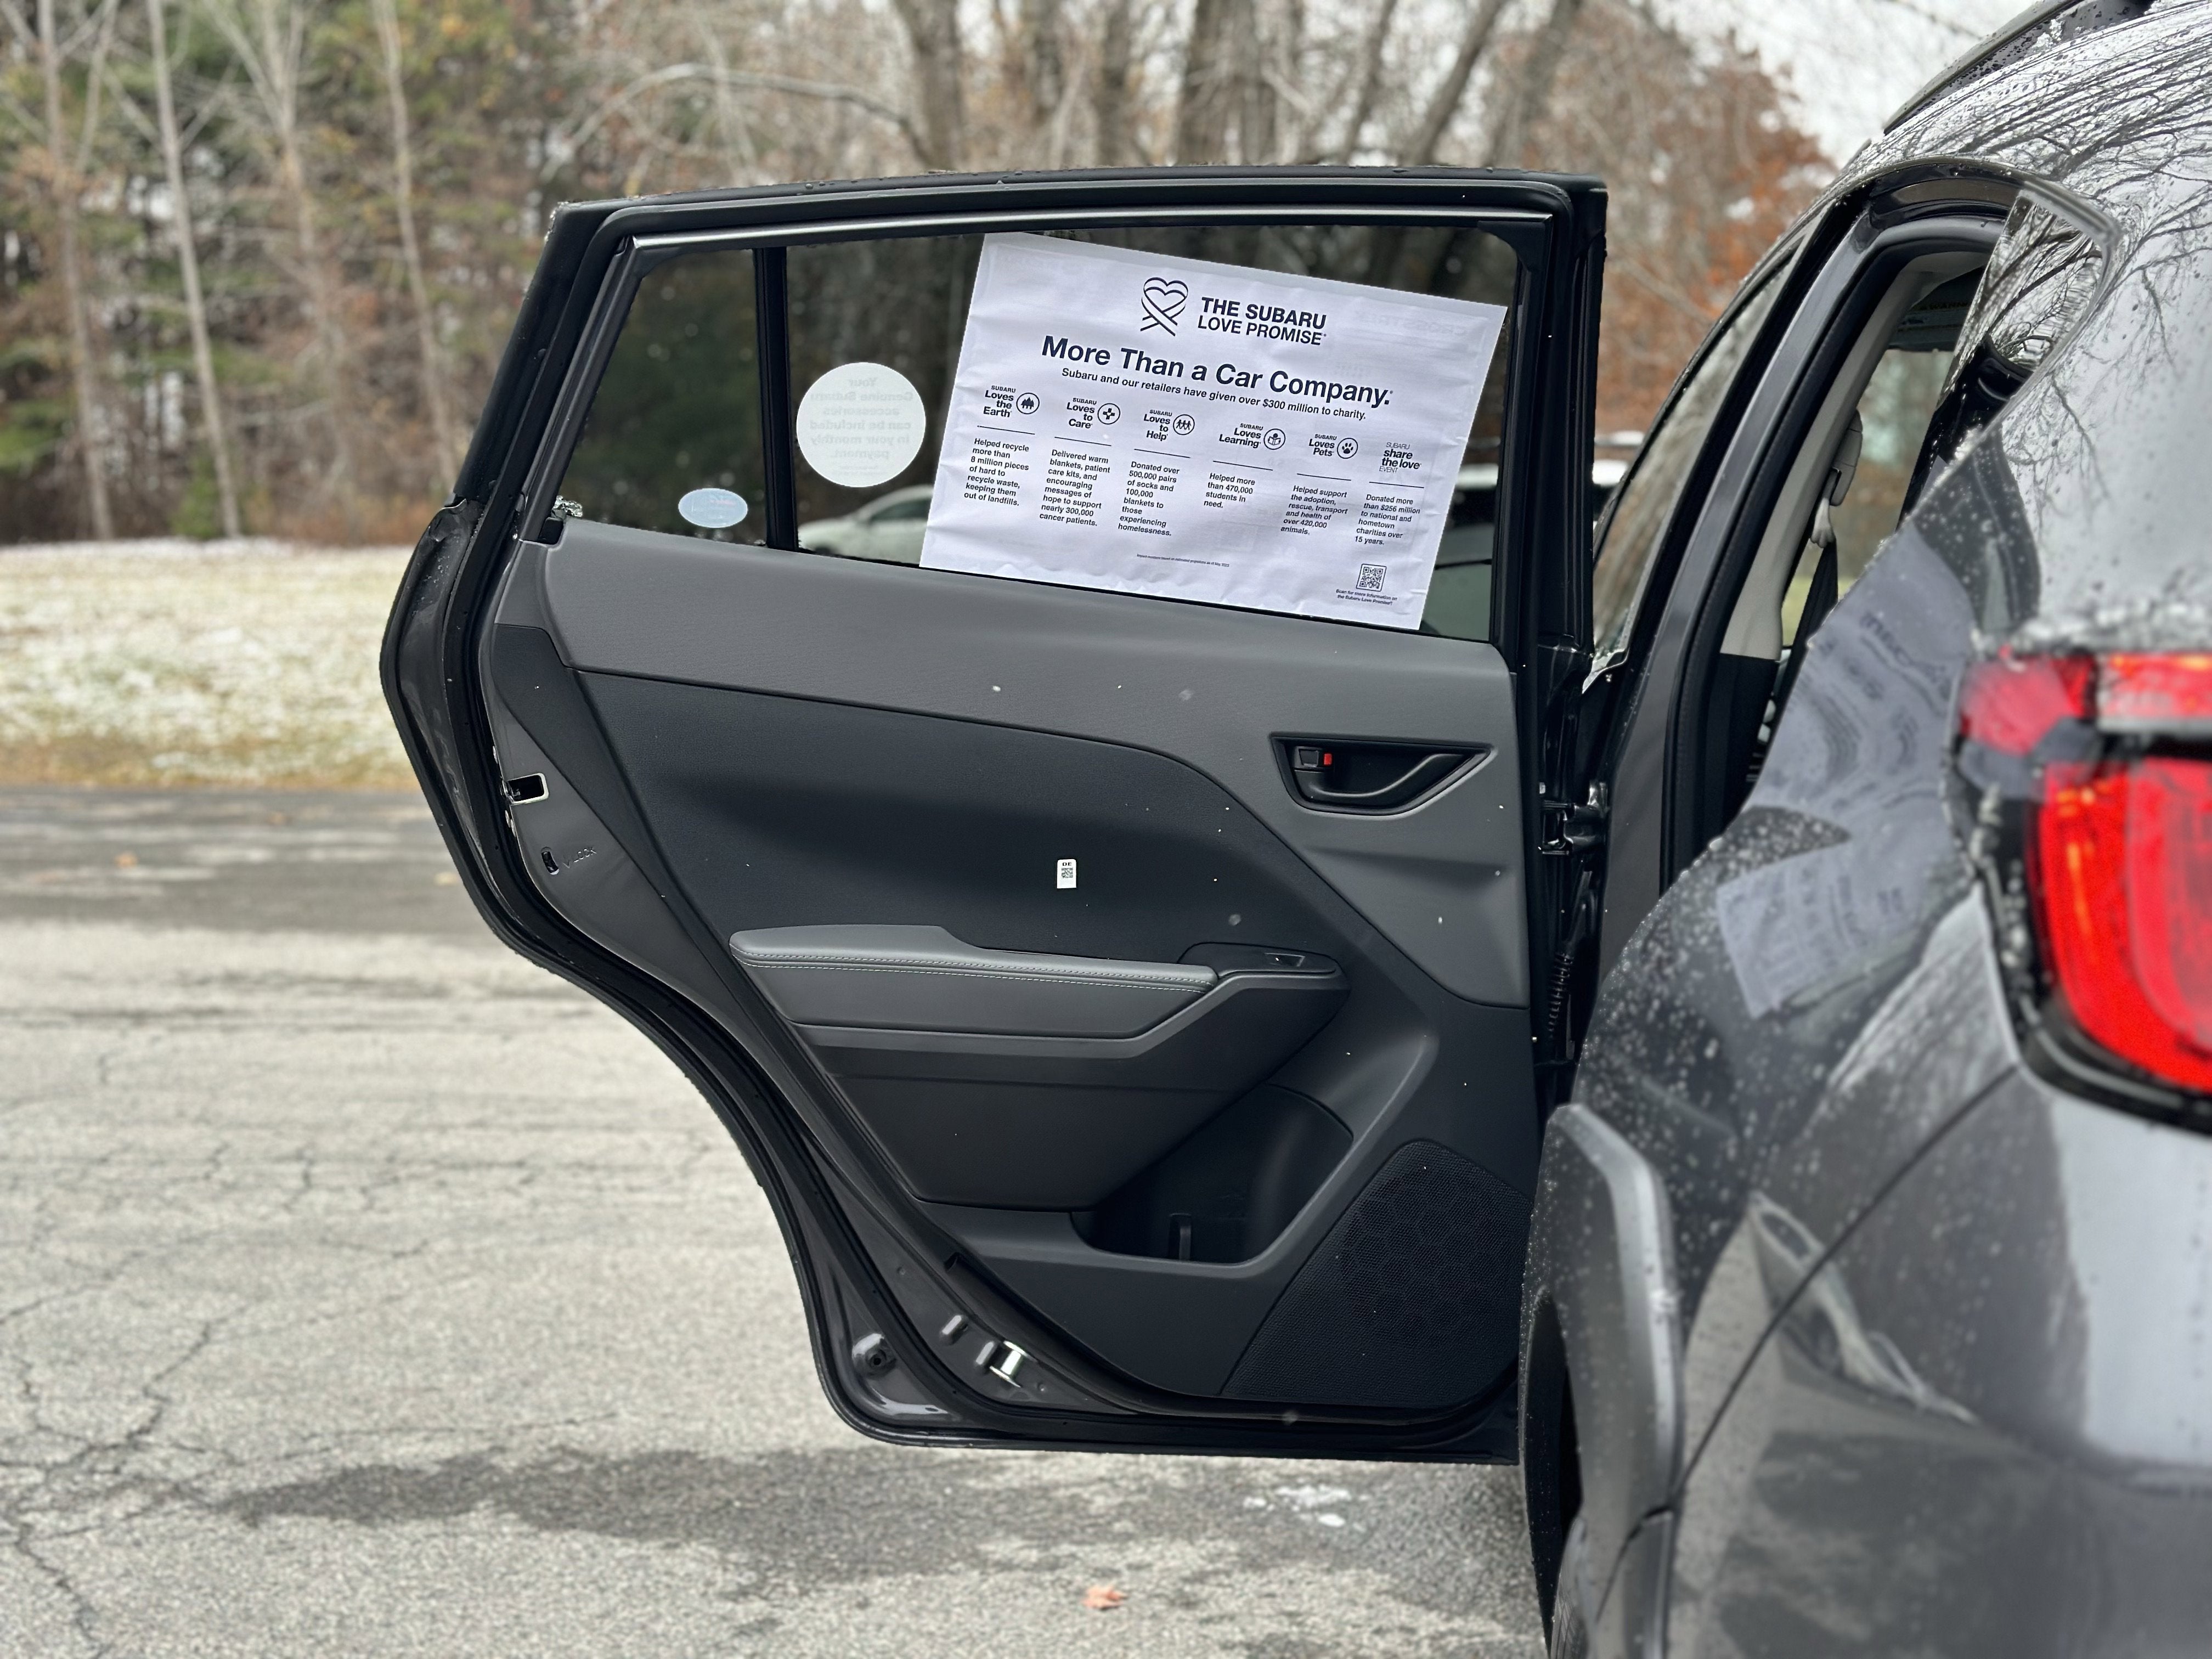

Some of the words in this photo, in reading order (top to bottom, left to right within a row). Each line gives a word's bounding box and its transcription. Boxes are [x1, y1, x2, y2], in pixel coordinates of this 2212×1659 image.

[1201, 296, 1240, 317] THE
[1245, 303, 1327, 329] SUBARU
[1197, 314, 1242, 334] LOVE
[1041, 335, 1110, 365] More
[1120, 347, 1183, 377] Than
[1191, 365, 1207, 381] a
[1216, 363, 1263, 388] Car
[991, 385, 1015, 393] SUBARU
[1062, 368, 1098, 381] Subaru
[1100, 375, 1119, 384] and
[1121, 379, 1139, 387] our
[1141, 382, 1181, 393] retailers
[1183, 386, 1206, 397] have
[1209, 391, 1235, 402] given
[1238, 397, 1261, 405] over
[1262, 398, 1285, 409] $300
[1287, 403, 1319, 413] million
[1321, 406, 1330, 415] to
[1333, 408, 1365, 421] charity.
[984, 390, 1014, 401] Loves
[996, 399, 1012, 409] the
[1066, 402, 1095, 413] Loves
[1083, 413, 1093, 421] to
[1143, 413, 1170, 425] Loves
[1159, 424, 1169, 432] to
[1233, 427, 1261, 439] Loves
[974, 437, 1001, 447] Helped
[1002, 443, 1029, 452] recycle
[1308, 438, 1335, 448] Loves
[994, 450, 1010, 458] than
[1051, 449, 1086, 460] Delivered
[1383, 448, 1413, 459] share
[977, 457, 1002, 466] million
[1004, 461, 1029, 470] pieces
[1049, 458, 1083, 470] blankets,
[1084, 465, 1110, 473] patient
[1131, 461, 1161, 471] Donated
[1382, 458, 1398, 467] the
[978, 466, 996, 475] hard
[1065, 470, 1081, 479] kits,
[1128, 470, 1157, 480] 500,000
[967, 475, 995, 483] recycle
[996, 479, 1020, 489] waste,
[1209, 472, 1235, 482] Helped
[965, 482, 995, 494] keeping
[997, 487, 1016, 496] them
[1046, 477, 1092, 490] encouraging
[1207, 482, 1223, 490] than
[1225, 484, 1253, 494] 470,000
[1044, 487, 1081, 497] messages
[1126, 488, 1153, 498] 100,000
[1293, 485, 1318, 494] Helped
[988, 494, 1019, 506] landfills.
[1205, 491, 1237, 500] students
[1303, 496, 1336, 506] adoption,
[1365, 494, 1395, 503] Donated
[1042, 494, 1062, 504] hope
[1072, 500, 1102, 509] support
[1123, 496, 1154, 507] blankets
[1041, 504, 1064, 514] nearly
[1065, 506, 1093, 516] 300,000
[1122, 506, 1142, 514] those
[1288, 503, 1313, 511] rescue,
[1315, 505, 1348, 514] transport
[1065, 517, 1097, 526] patients.
[1119, 516, 1166, 528] experiencing
[1369, 512, 1398, 521] national
[1118, 522, 1171, 535] homelessness.
[1300, 519, 1327, 528] 420,000
[1358, 518, 1395, 529] hometown
[1280, 526, 1310, 535] animals.
[1356, 527, 1386, 537] charities
